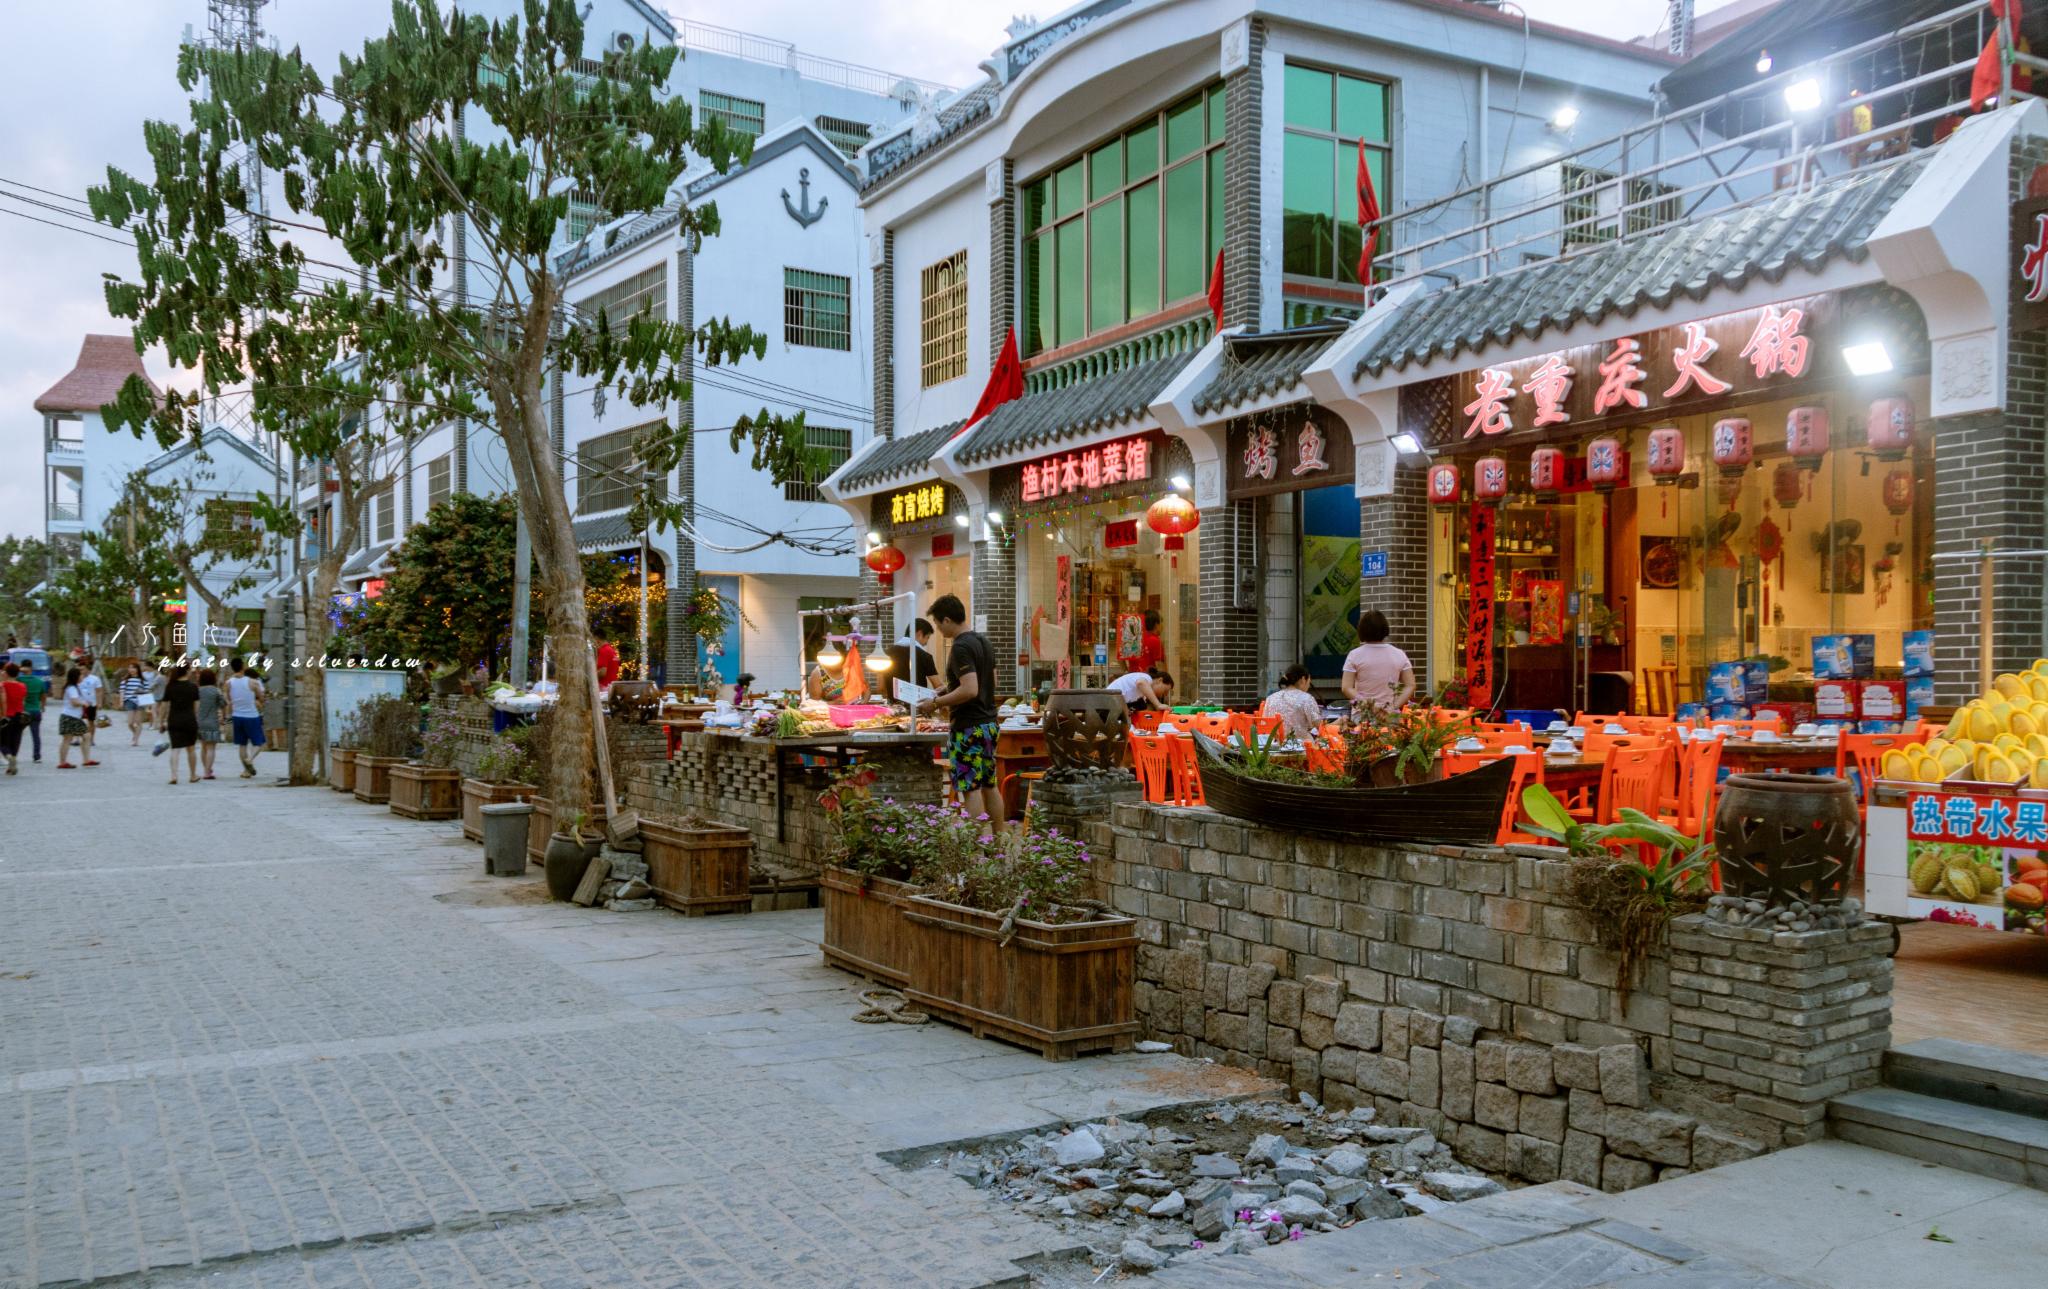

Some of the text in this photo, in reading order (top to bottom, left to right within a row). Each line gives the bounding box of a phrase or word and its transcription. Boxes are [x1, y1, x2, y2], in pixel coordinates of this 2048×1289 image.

[1463, 306, 1812, 439] 老重庆火锅
[1022, 438, 1149, 502] 渔村本地菜馆
[1243, 421, 1328, 479] 烤鱼
[891, 484, 945, 524] 夜宵烧烤
[1367, 560, 1382, 571] 104
[1911, 795, 2048, 843] 热带水果
